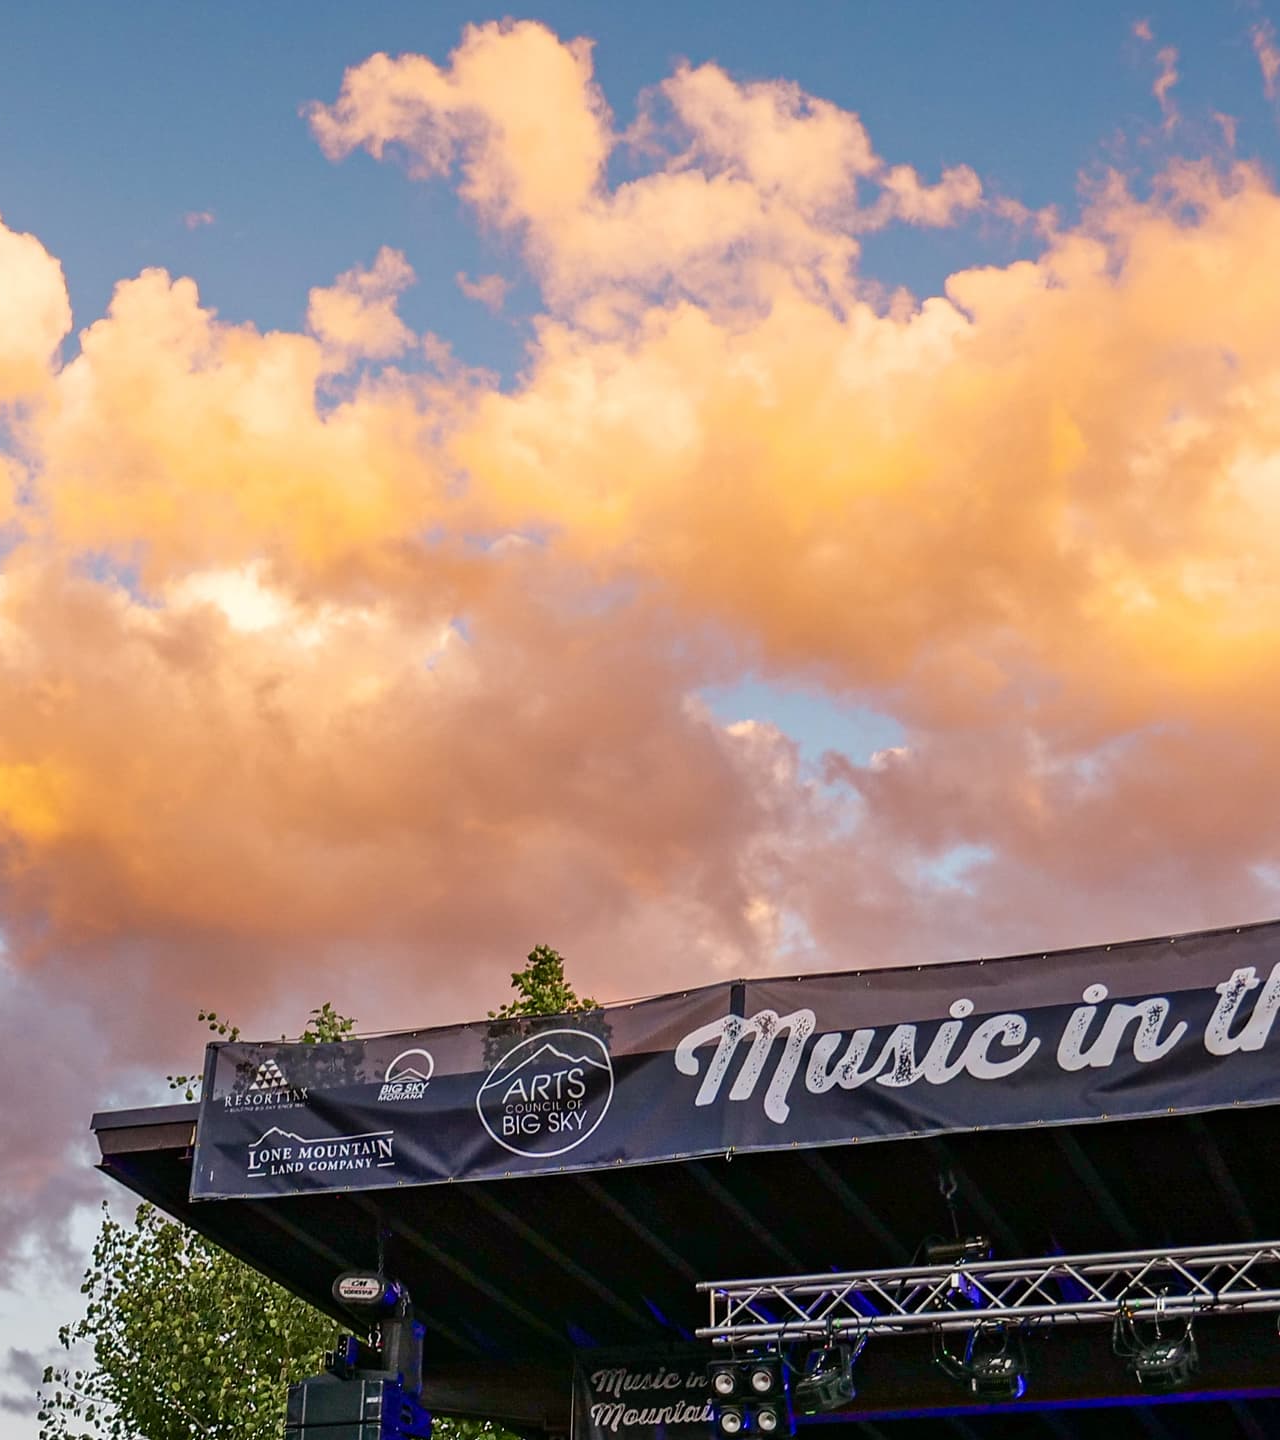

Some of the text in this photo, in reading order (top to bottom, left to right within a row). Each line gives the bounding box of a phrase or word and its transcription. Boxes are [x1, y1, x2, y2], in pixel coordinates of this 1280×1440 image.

[674, 999, 1040, 1124] Music
[1056, 984, 1188, 1072] in
[378, 1091, 423, 1101] MONTANA
[381, 1081, 430, 1095] BIG SKY
[502, 1068, 586, 1104] ARTS
[505, 1100, 583, 1115] COUNCIL OF
[502, 1110, 587, 1136] BIG SKY
[248, 1138, 394, 1170] LONE MOUNTAIN
[271, 1158, 373, 1175] LAND COMPANY
[591, 1367, 708, 1398] Music in
